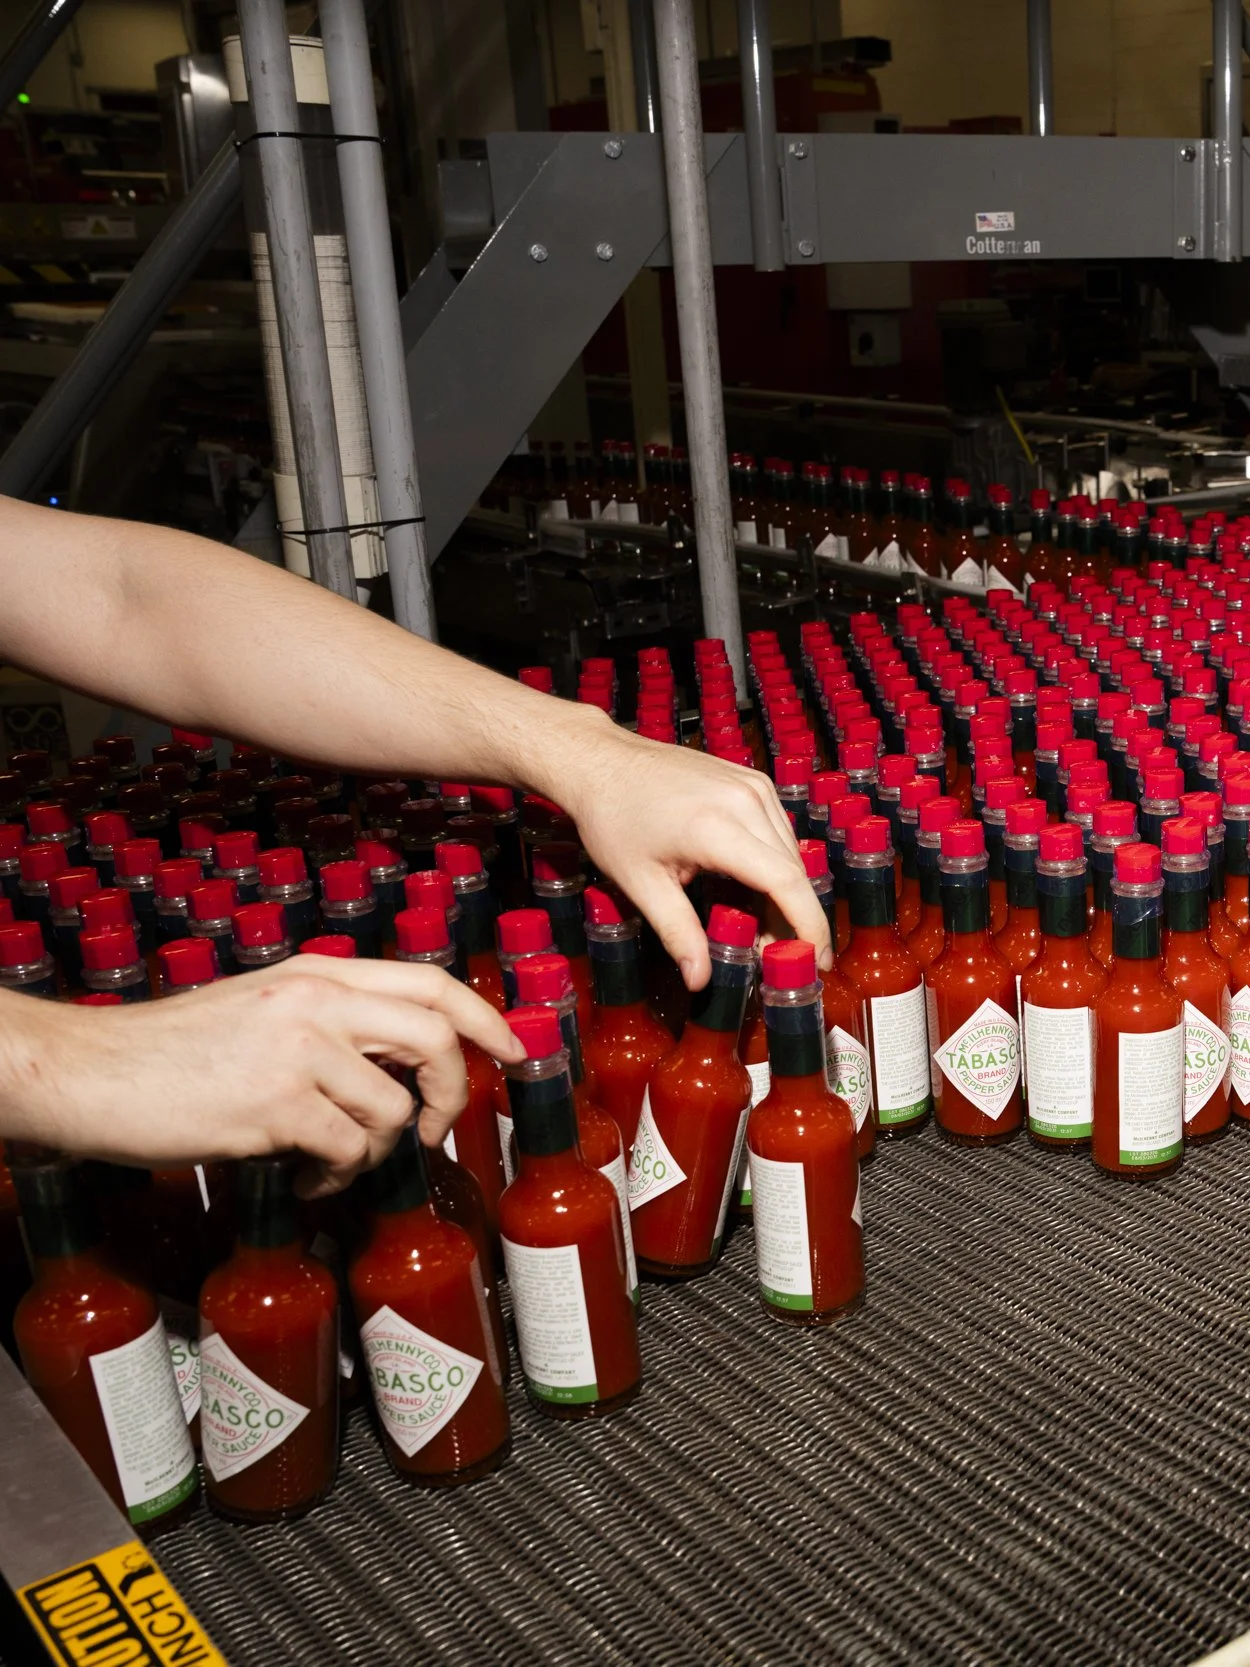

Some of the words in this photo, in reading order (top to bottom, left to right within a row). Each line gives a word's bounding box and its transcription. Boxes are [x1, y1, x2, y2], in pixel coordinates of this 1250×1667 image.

[945, 1038, 1020, 1070] TABASCO
[960, 1070, 995, 1094] PEPPER
[997, 1062, 1017, 1092] SAUCE
[977, 1067, 1007, 1080] BRAND
[1191, 1067, 1218, 1095] SAUCE
[375, 1366, 465, 1394] BASCO
[384, 1392, 423, 1406] BRAND
[410, 1392, 448, 1425] SAUCE
[222, 1430, 262, 1454] SAUCE
